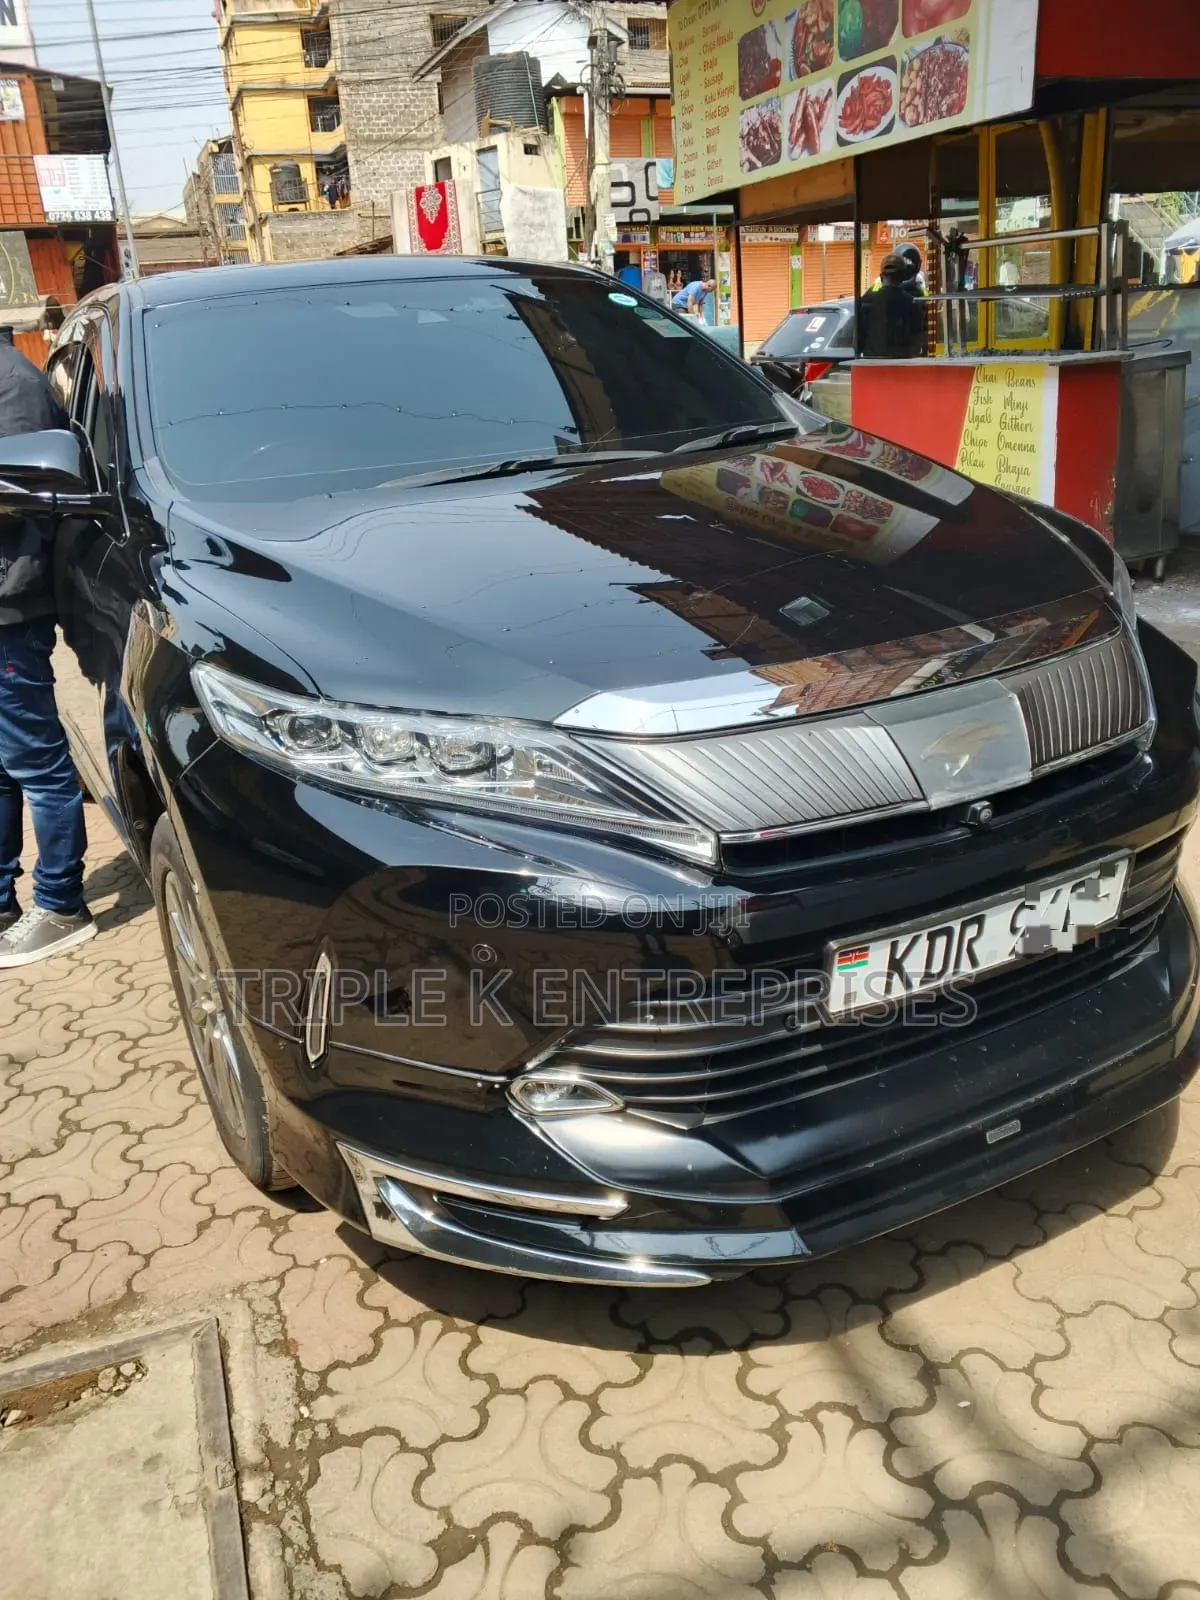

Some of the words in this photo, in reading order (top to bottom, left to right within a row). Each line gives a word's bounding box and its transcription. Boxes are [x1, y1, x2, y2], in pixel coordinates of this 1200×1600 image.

[975, 364, 997, 384] Chai
[1005, 367, 1036, 388] Beans
[973, 386, 993, 405] Fish
[968, 407, 992, 430] Ugali
[963, 429, 988, 452] Chipo
[959, 447, 985, 468] Pilau
[884, 913, 988, 998] KDR
